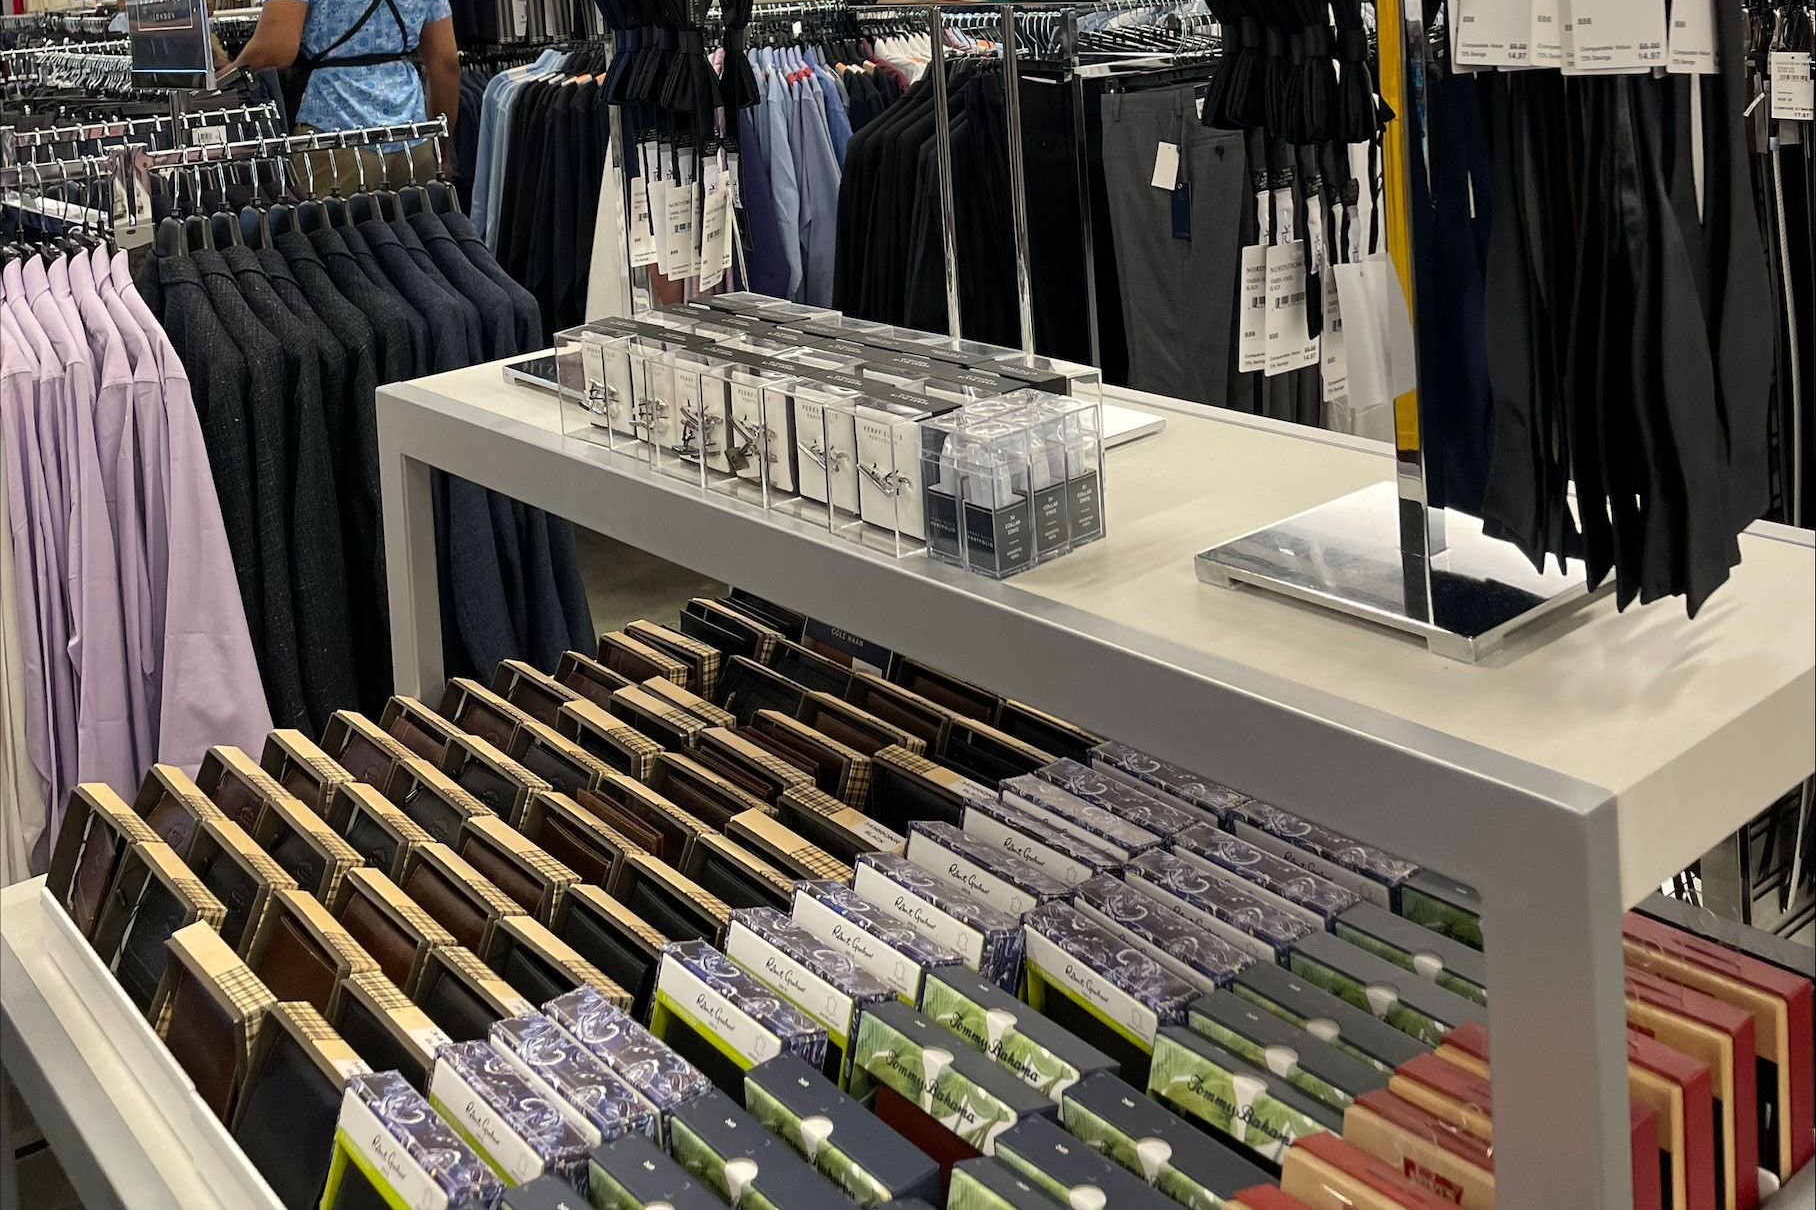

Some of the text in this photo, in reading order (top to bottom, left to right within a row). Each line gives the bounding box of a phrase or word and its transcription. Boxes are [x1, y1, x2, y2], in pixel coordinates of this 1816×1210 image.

[967, 534, 994, 548] PORTFOLIO
[831, 627, 848, 640] COLE
[949, 1011, 1041, 1083] Tommy Bahama
[885, 1049, 977, 1125] Tommy Bahama
[1187, 1074, 1290, 1146] Tommy Baham
